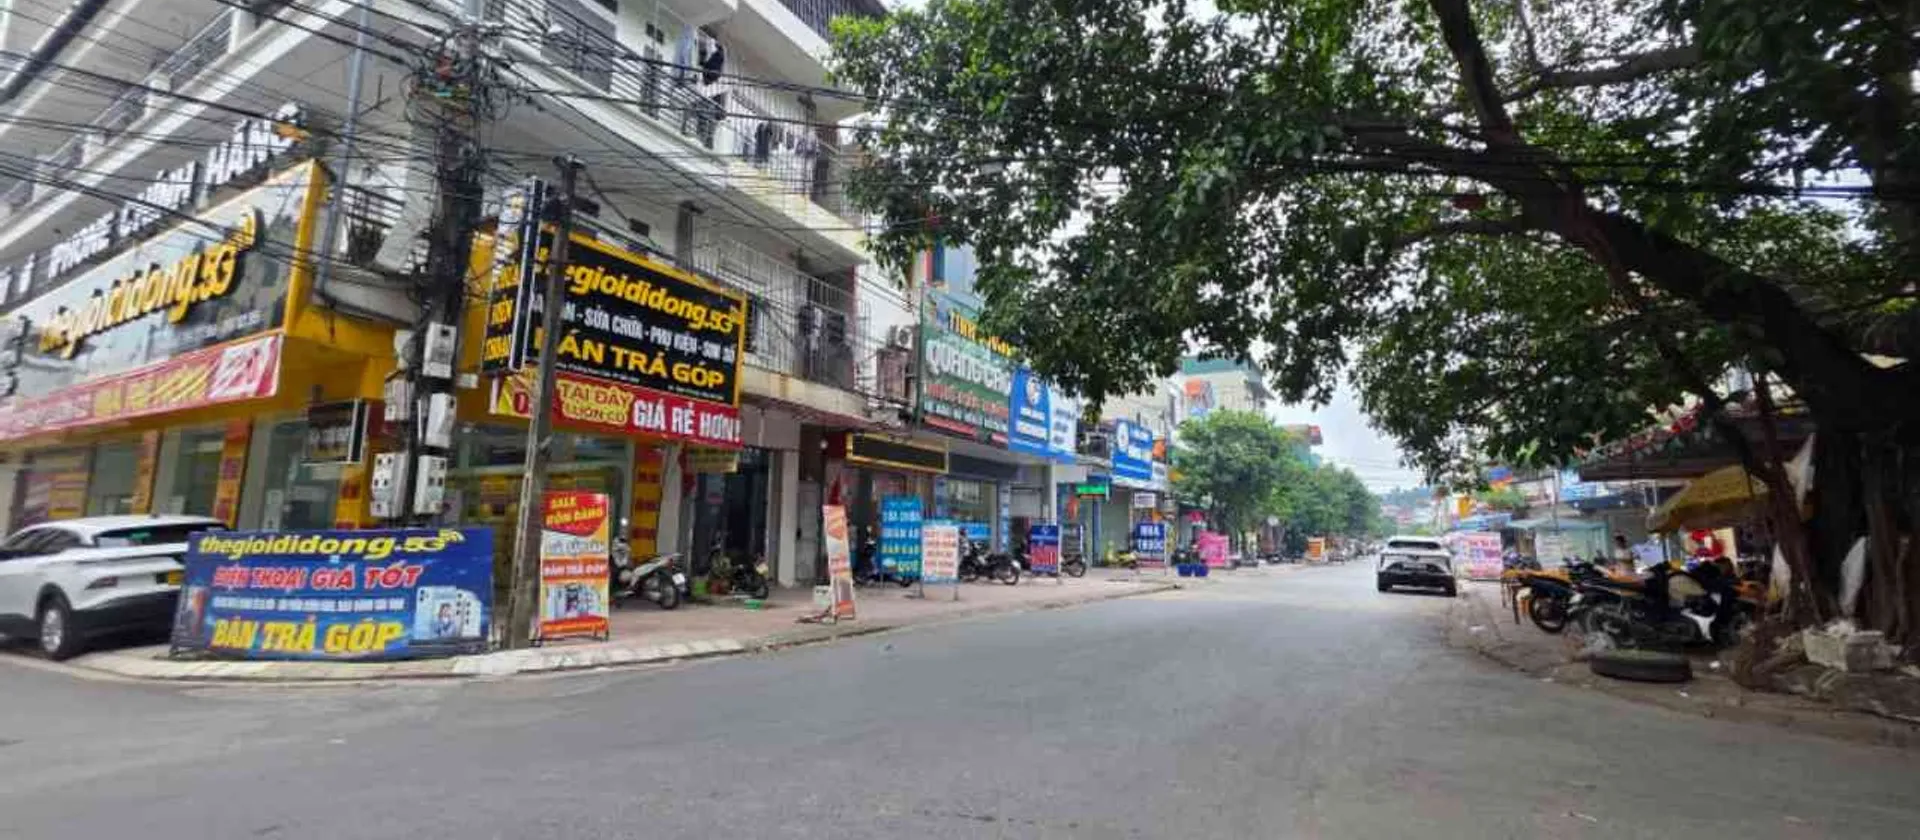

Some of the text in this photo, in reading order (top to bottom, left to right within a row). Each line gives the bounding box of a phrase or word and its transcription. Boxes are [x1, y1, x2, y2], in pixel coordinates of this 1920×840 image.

[609, 343, 668, 379] TRẢ
[671, 360, 725, 389] GÓP
[633, 397, 742, 443] GIÁ RẺ HƠN!
[311, 562, 355, 591] GIÁ
[363, 559, 425, 590] TỐT
[210, 615, 405, 654] BÁN TRẢ GÓP
